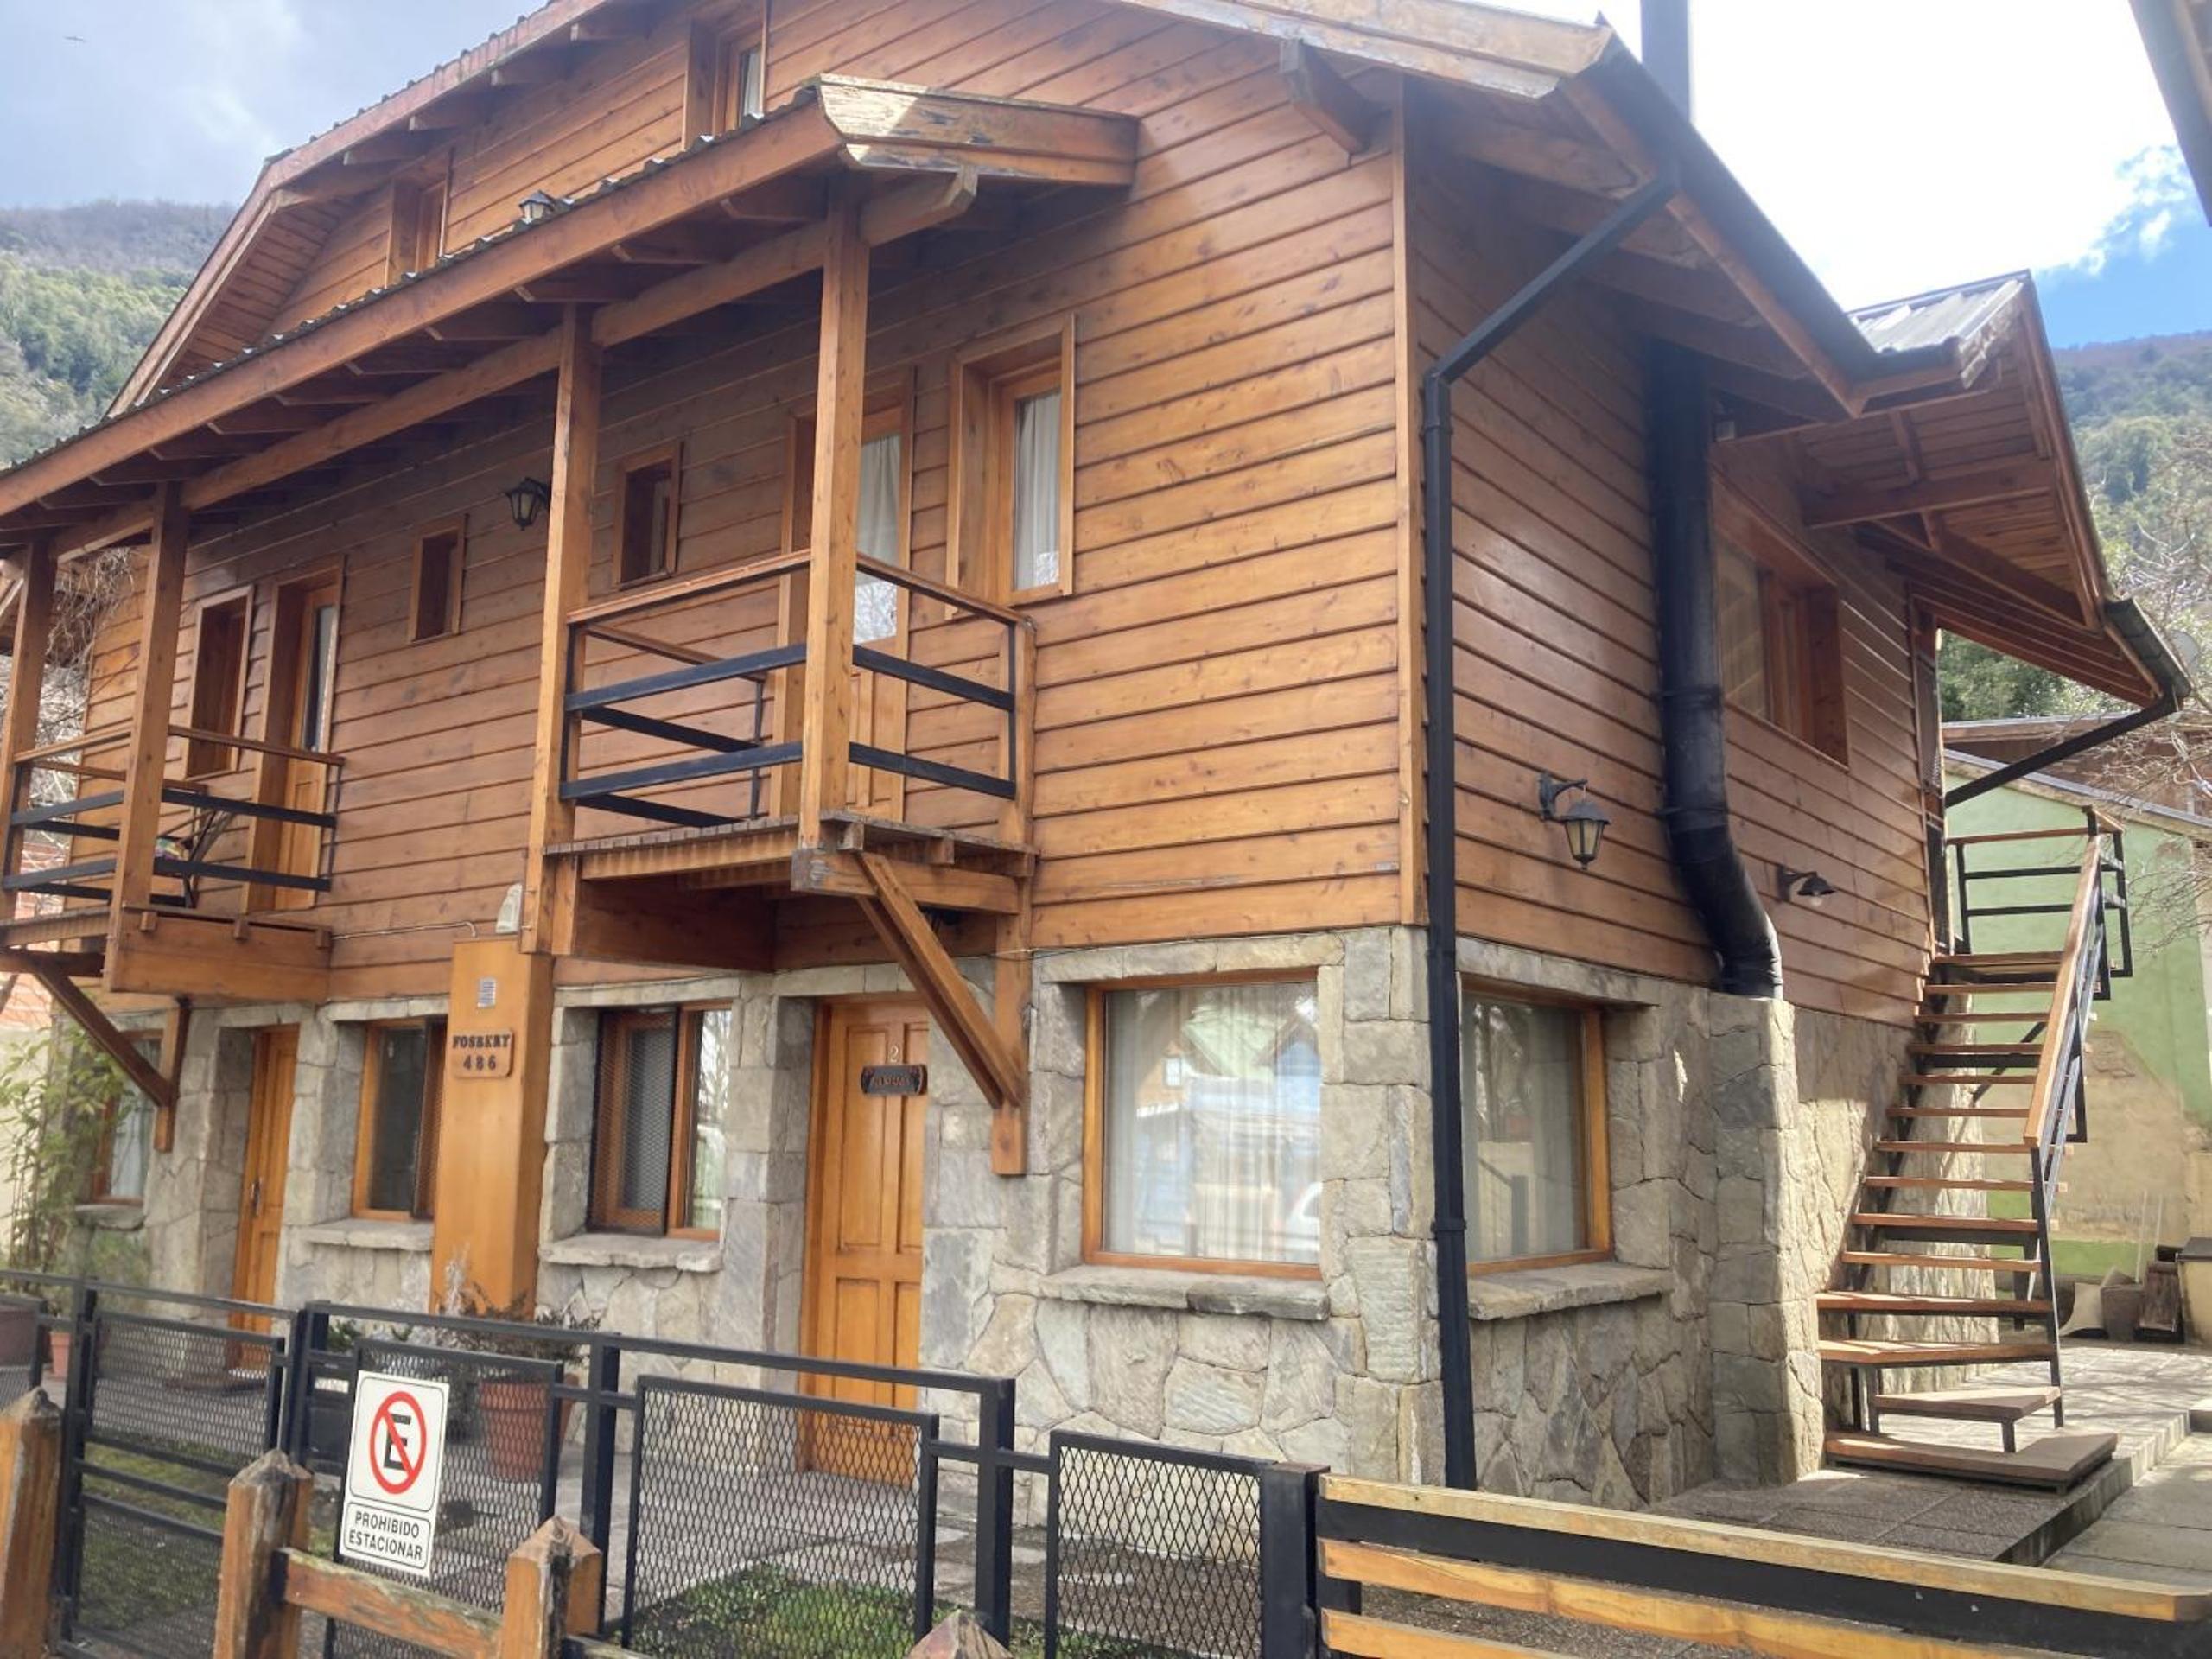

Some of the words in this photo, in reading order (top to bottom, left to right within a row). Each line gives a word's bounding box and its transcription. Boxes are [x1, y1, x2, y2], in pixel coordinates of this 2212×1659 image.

[462, 1054, 496, 1071] 486
[384, 1414, 411, 1471] E
[355, 1510, 420, 1538] PROHIBIDO
[349, 1529, 423, 1560] ESTACIONAR
